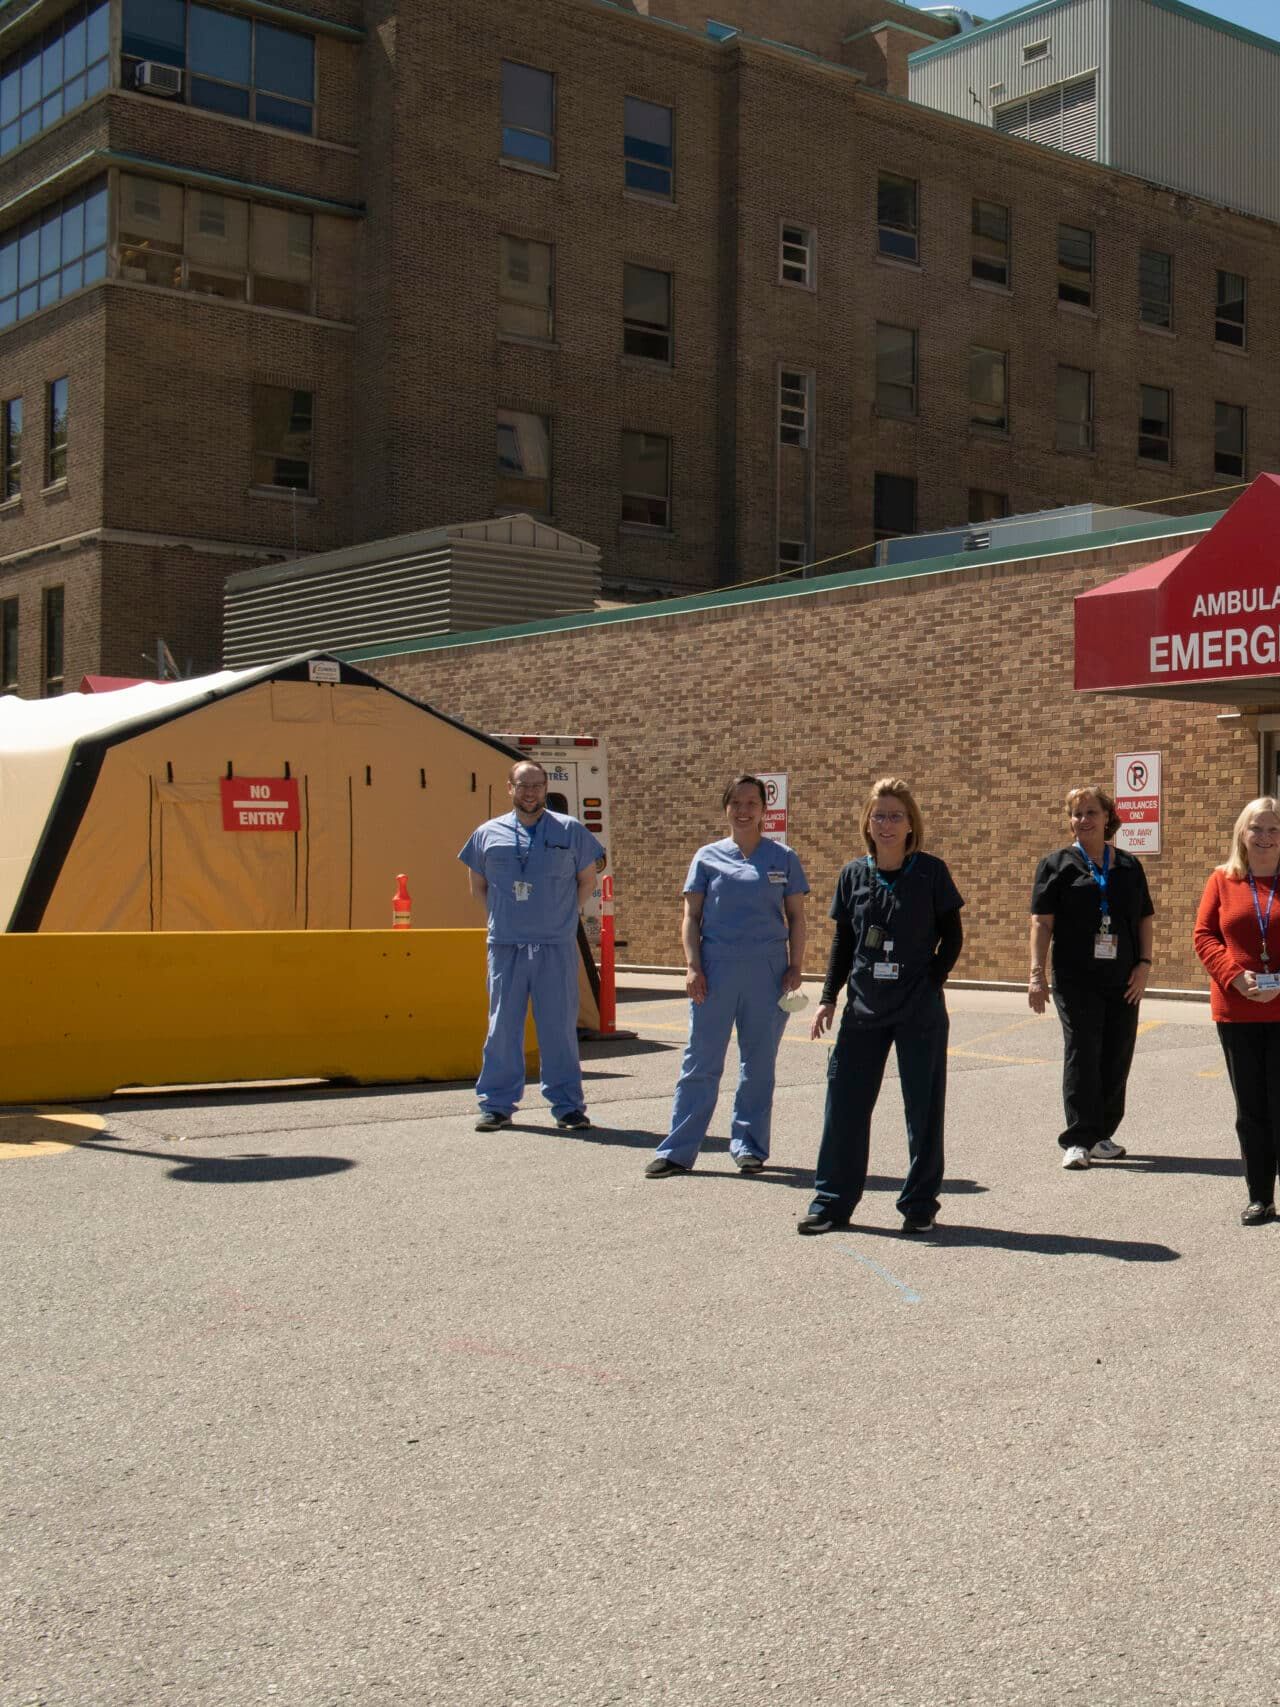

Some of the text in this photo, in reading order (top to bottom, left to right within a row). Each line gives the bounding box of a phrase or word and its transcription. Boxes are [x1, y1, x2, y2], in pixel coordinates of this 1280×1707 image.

[250, 785, 271, 799] NO
[1118, 801, 1158, 810] AMBULANCES
[239, 811, 285, 825] ENTRY
[1129, 811, 1145, 820] ONLY
[1122, 828, 1153, 837] TOW AWAY
[1128, 837, 1145, 846] ZONE
